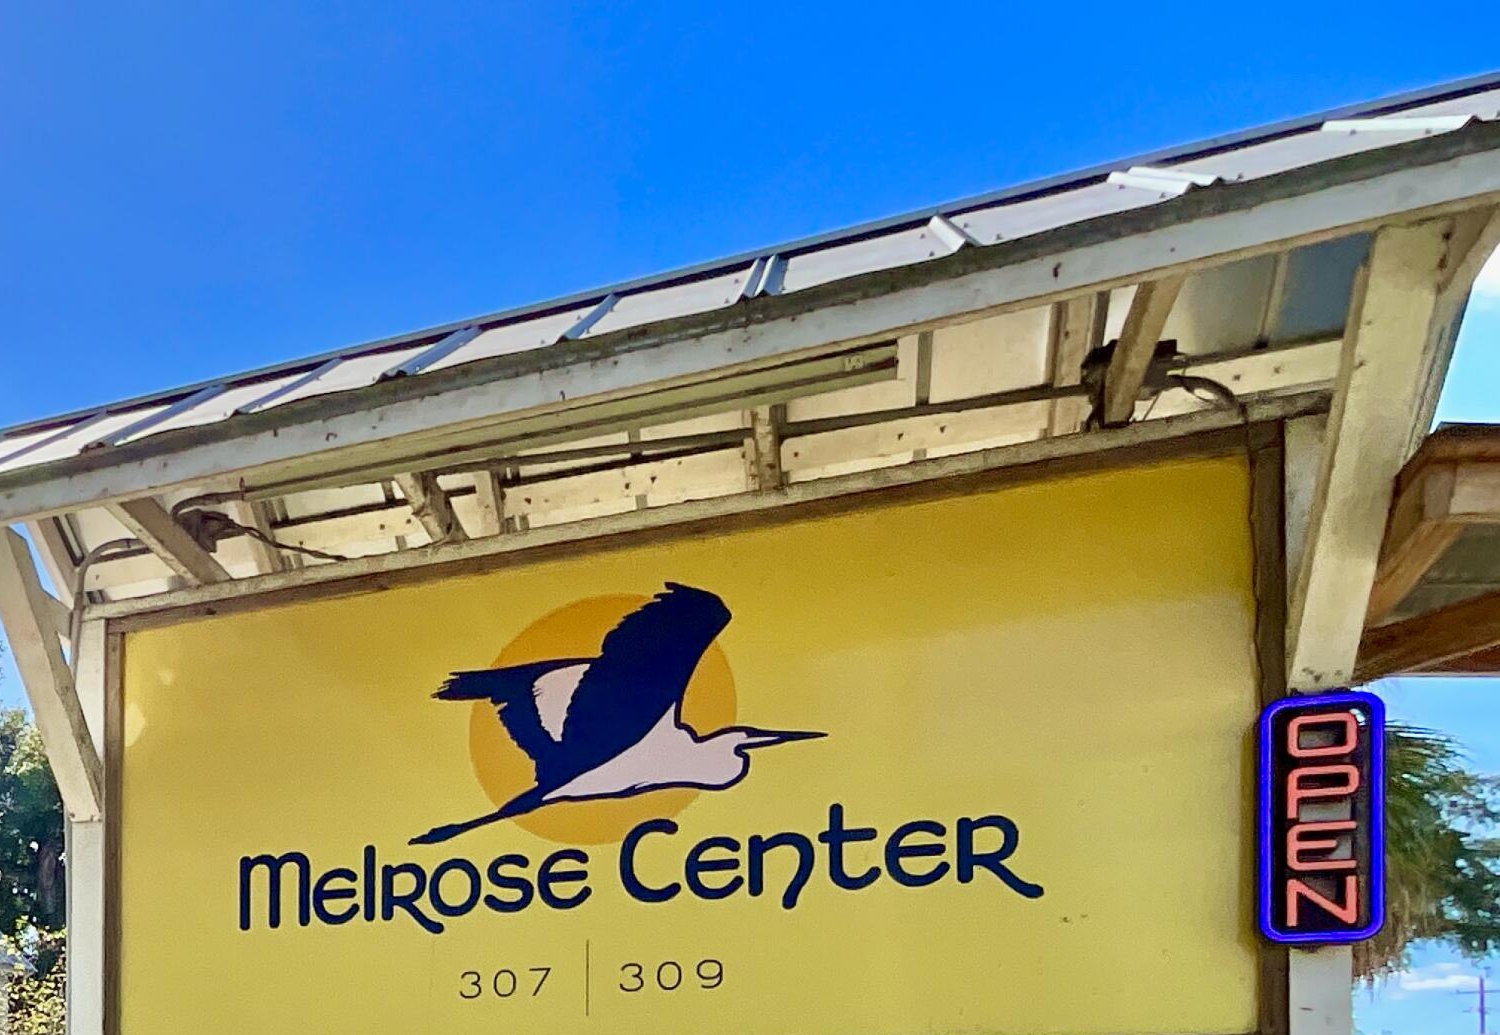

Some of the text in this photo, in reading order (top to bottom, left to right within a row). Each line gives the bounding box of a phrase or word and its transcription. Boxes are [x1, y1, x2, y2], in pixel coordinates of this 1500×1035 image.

[1286, 711, 1359, 927] OPEN
[459, 959, 724, 999] 307 309
